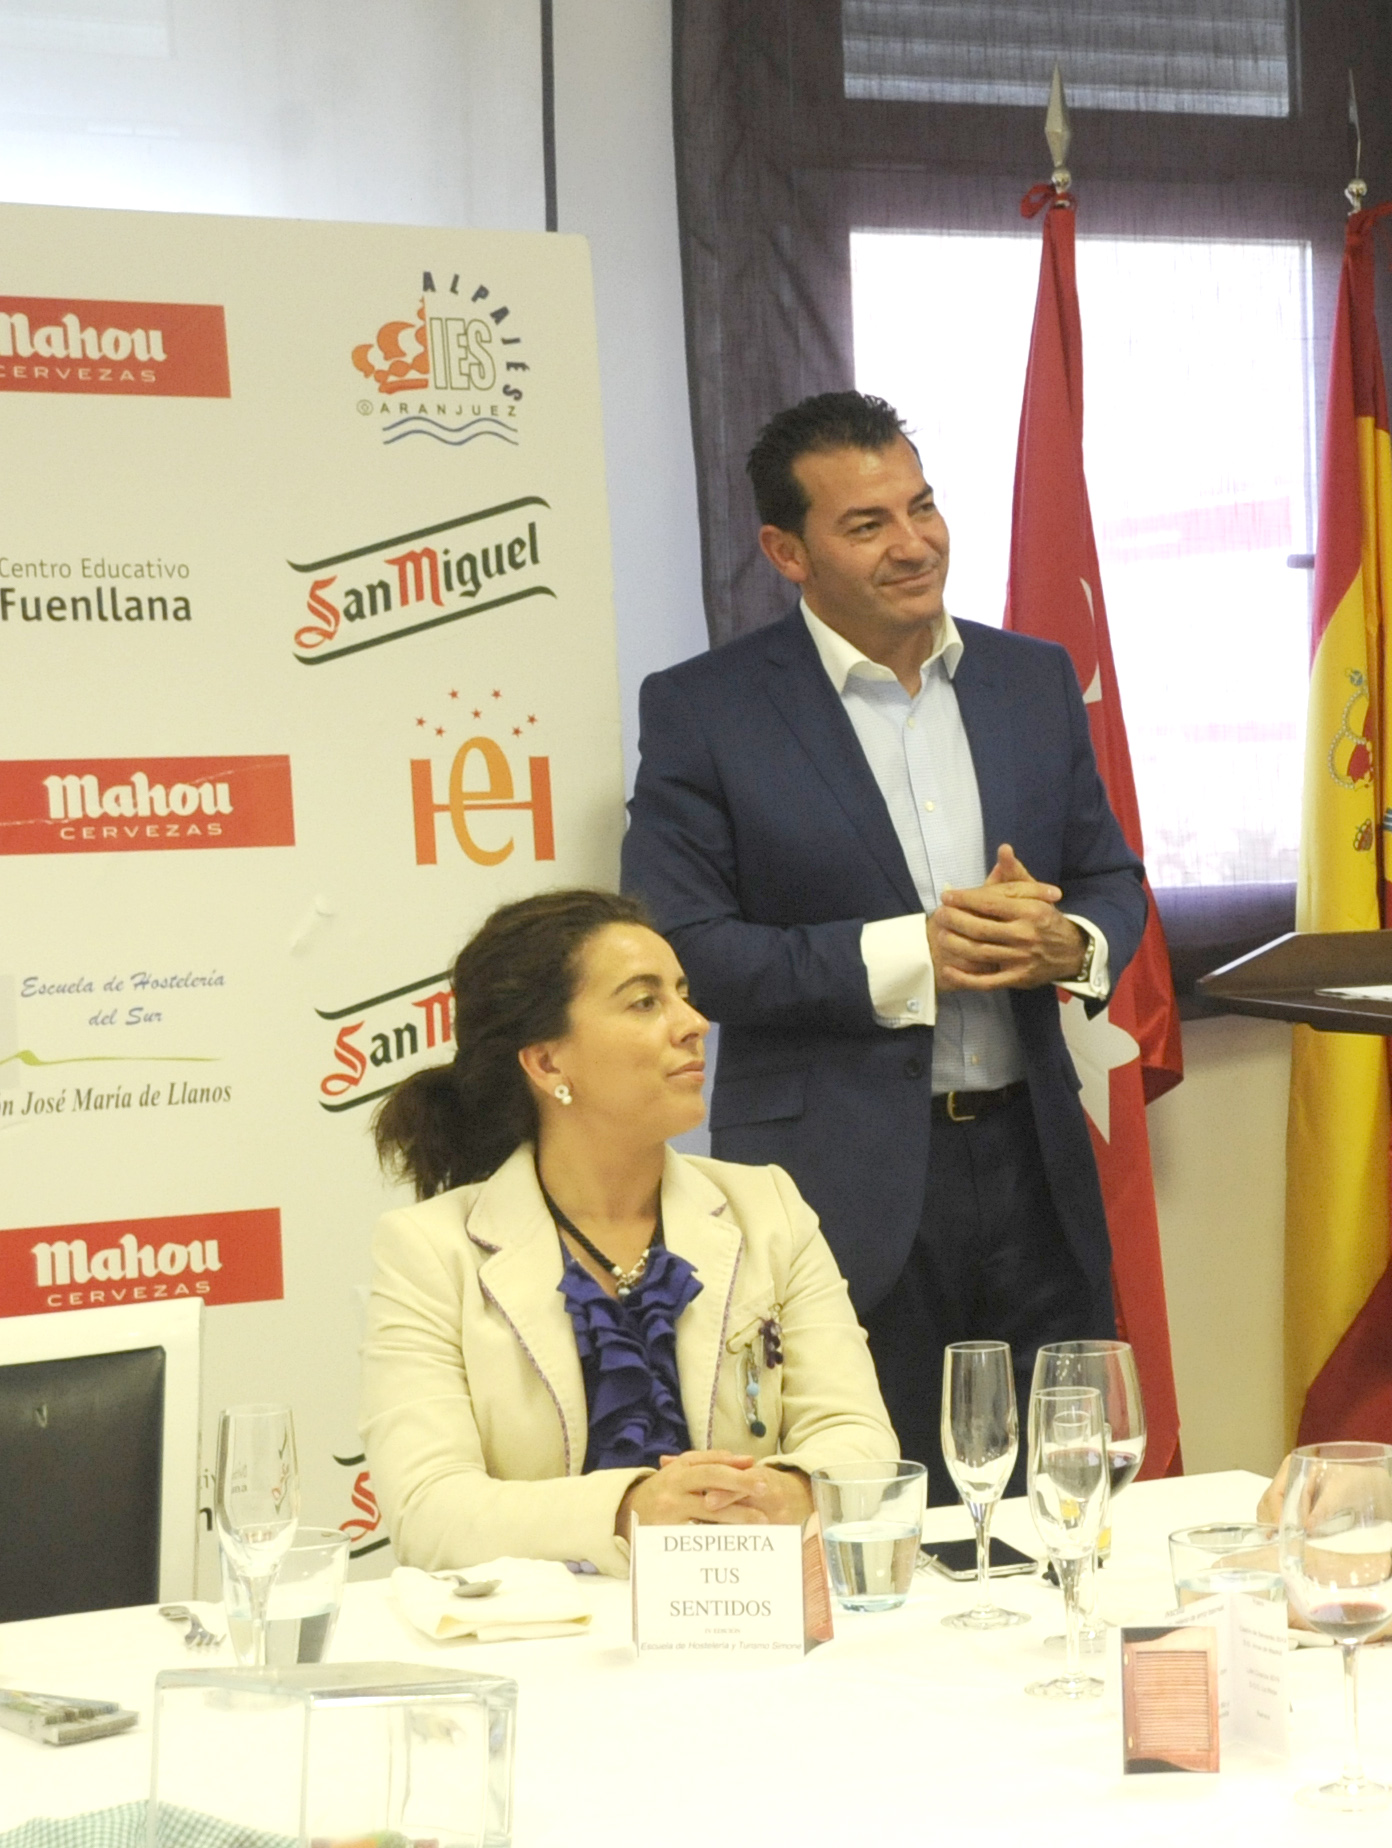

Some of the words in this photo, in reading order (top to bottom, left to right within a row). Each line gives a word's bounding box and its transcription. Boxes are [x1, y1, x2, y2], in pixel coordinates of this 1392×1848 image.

[428, 316, 497, 391] IES
[379, 402, 518, 417] ARANJUEZ
[0, 557, 72, 579] Centro
[81, 557, 190, 579] Educativo
[0, 586, 192, 622] Fuenllana
[43, 771, 234, 820] Mahou
[60, 823, 223, 840] CERVEZAS
[20, 976, 94, 998] Escuela
[103, 975, 125, 992] de
[130, 969, 225, 991] Hostelería
[88, 1008, 118, 1026] del
[125, 1006, 163, 1026] Sur
[21, 1088, 67, 1116] José
[72, 1084, 132, 1113] María
[139, 1084, 161, 1108] de
[167, 1081, 232, 1106] Llanos
[31, 1233, 222, 1287] Mahou
[47, 1280, 211, 1307] CERVEZAS
[663, 1535, 775, 1552] DESPIERTA
[700, 1567, 740, 1584] TUS
[669, 1600, 772, 1617] SENTIDOS
[641, 1642, 673, 1651] Escuela
[676, 1642, 685, 1650] de
[772, 1641, 802, 1650] Simone
